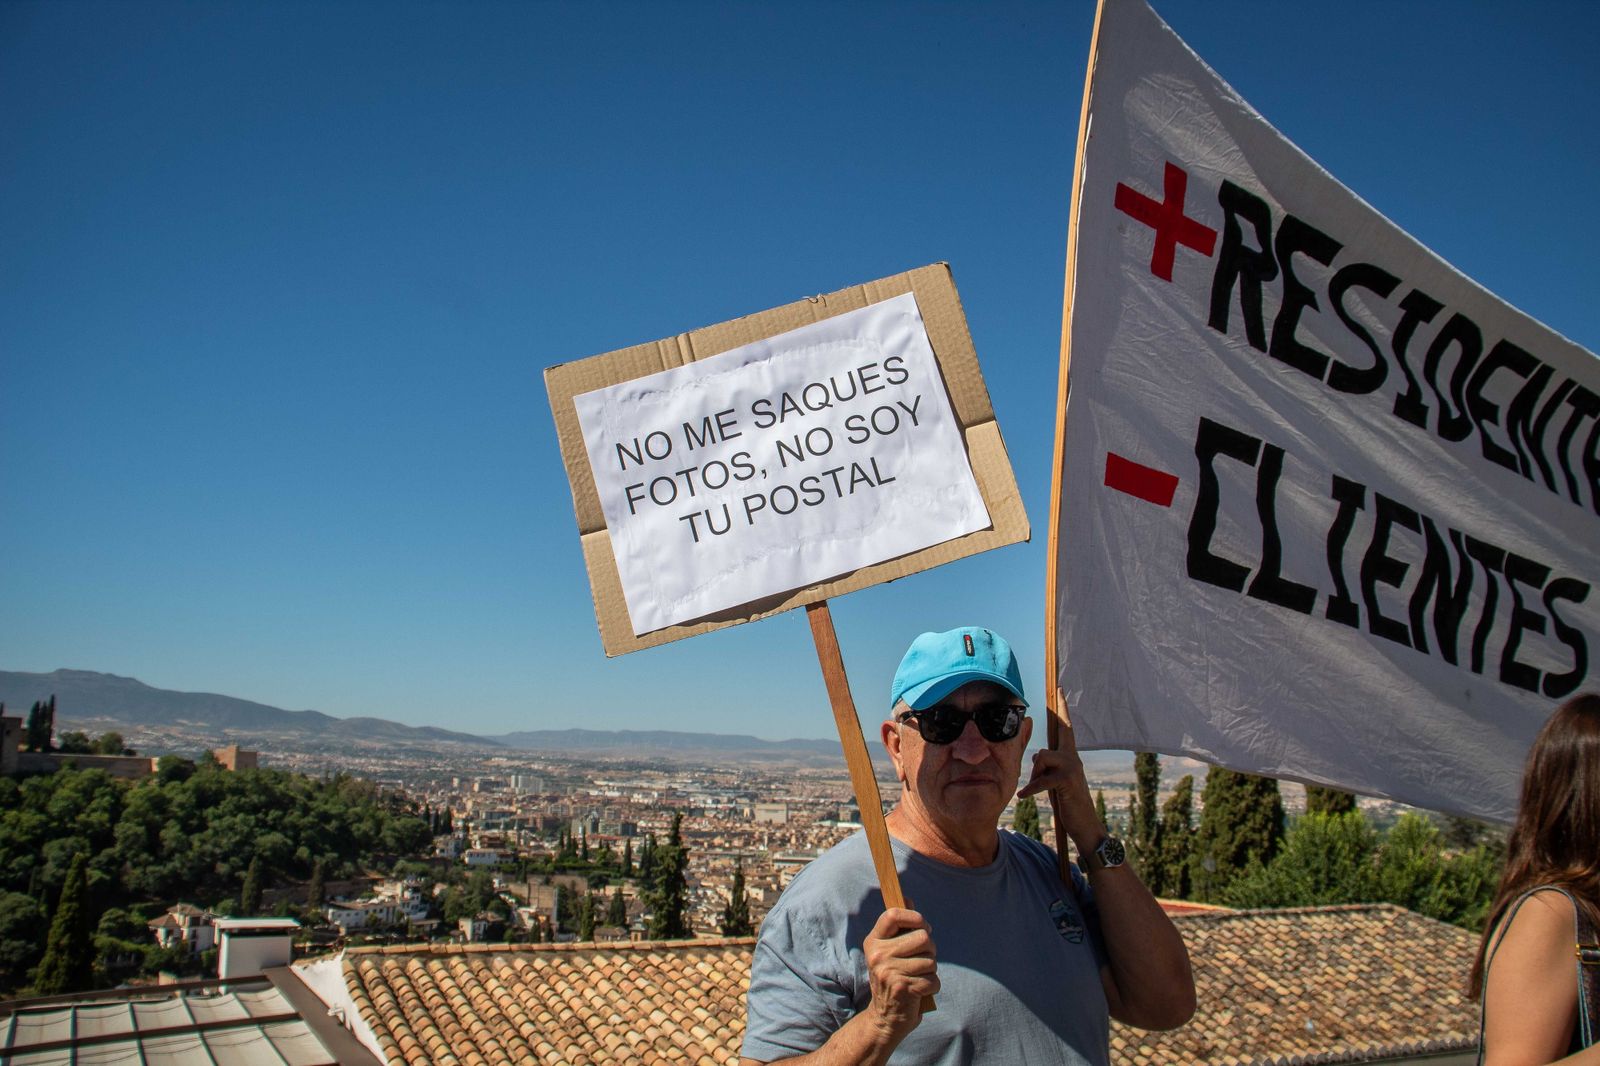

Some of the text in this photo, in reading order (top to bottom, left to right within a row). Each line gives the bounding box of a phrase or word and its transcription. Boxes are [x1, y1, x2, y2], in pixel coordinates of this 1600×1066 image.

[615, 356, 910, 470] NO ME SAQUES
[624, 395, 922, 515] FOTOS, NO SOY
[679, 456, 896, 543] TU POSTAL
[1187, 416, 1591, 698] CLIENTES
